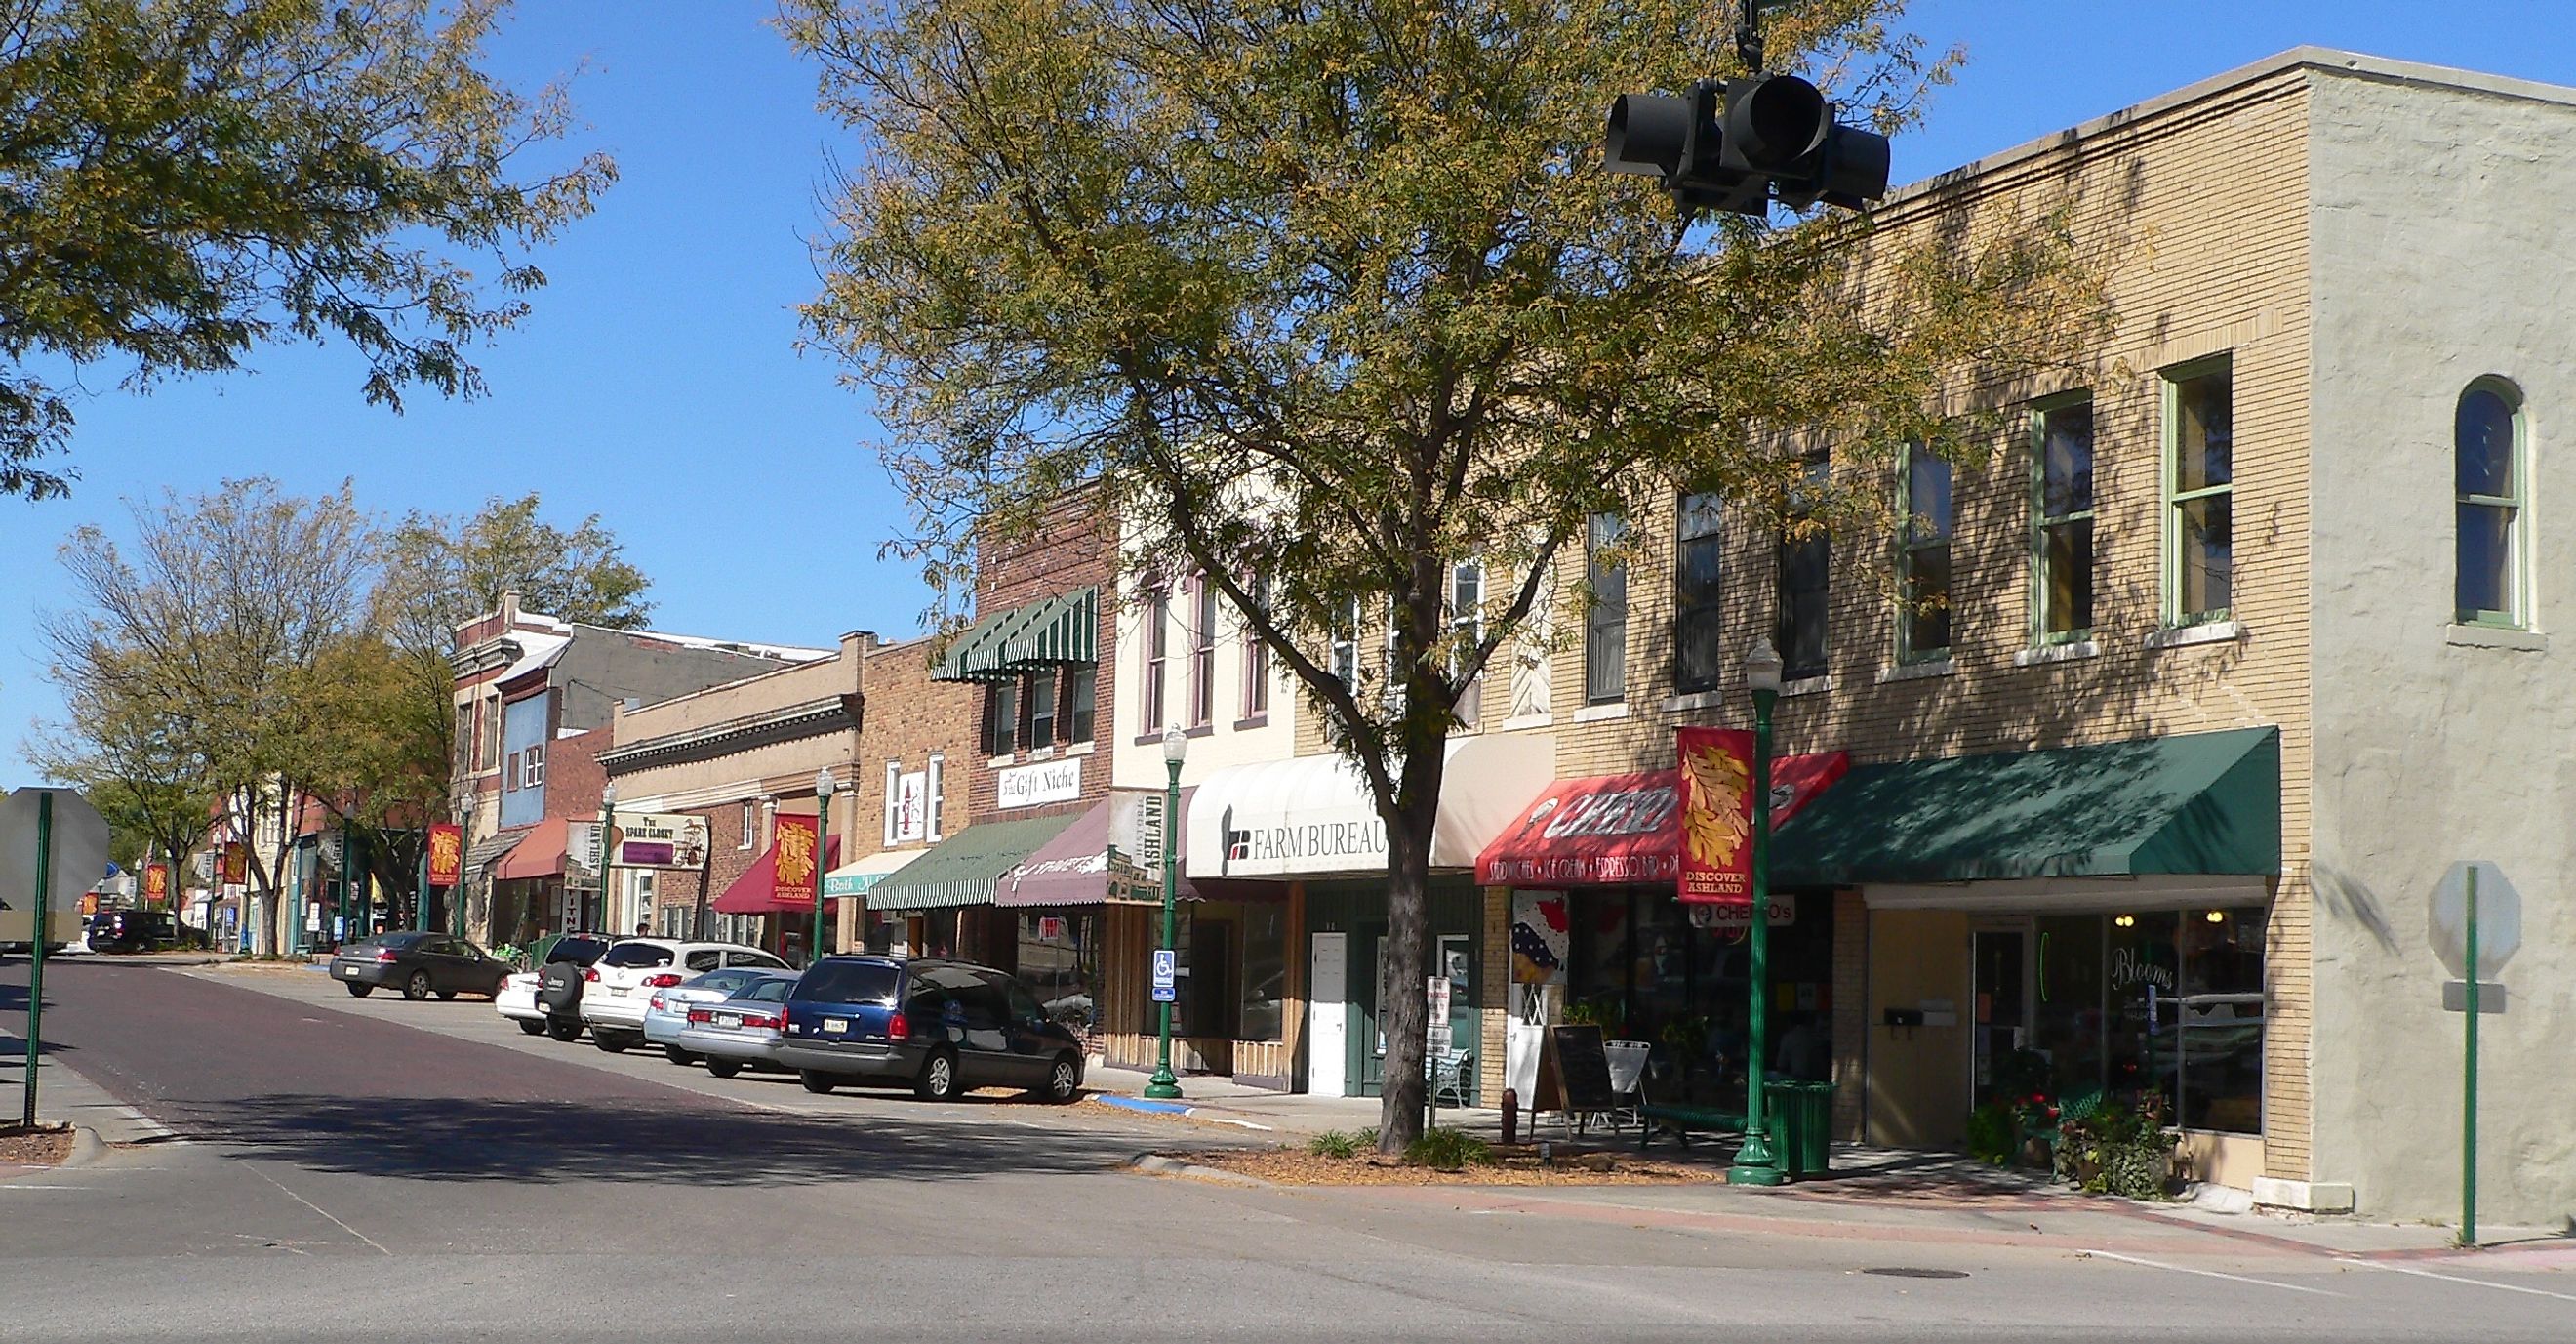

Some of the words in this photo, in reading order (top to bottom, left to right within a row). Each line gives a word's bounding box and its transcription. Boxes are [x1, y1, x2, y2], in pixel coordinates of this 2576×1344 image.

[1017, 770, 1037, 802] Gift
[1042, 765, 1074, 792] Niche
[1144, 795, 1162, 870] ASHLAND
[1253, 826, 1304, 860] FARM
[1308, 820, 1387, 857] BUREAU
[588, 824, 602, 872] ASHLAND
[1543, 858, 1557, 878] ICE
[1559, 858, 1586, 878] CREAM
[1595, 856, 1639, 877] ESPRESSO
[1642, 855, 1659, 876] BAR
[1686, 871, 1747, 882] DISCOVER
[828, 877, 854, 891] Bath
[1688, 881, 1743, 894] ASHLAND
[547, 976, 564, 987] Jeep
[2111, 947, 2173, 991] Blooms
